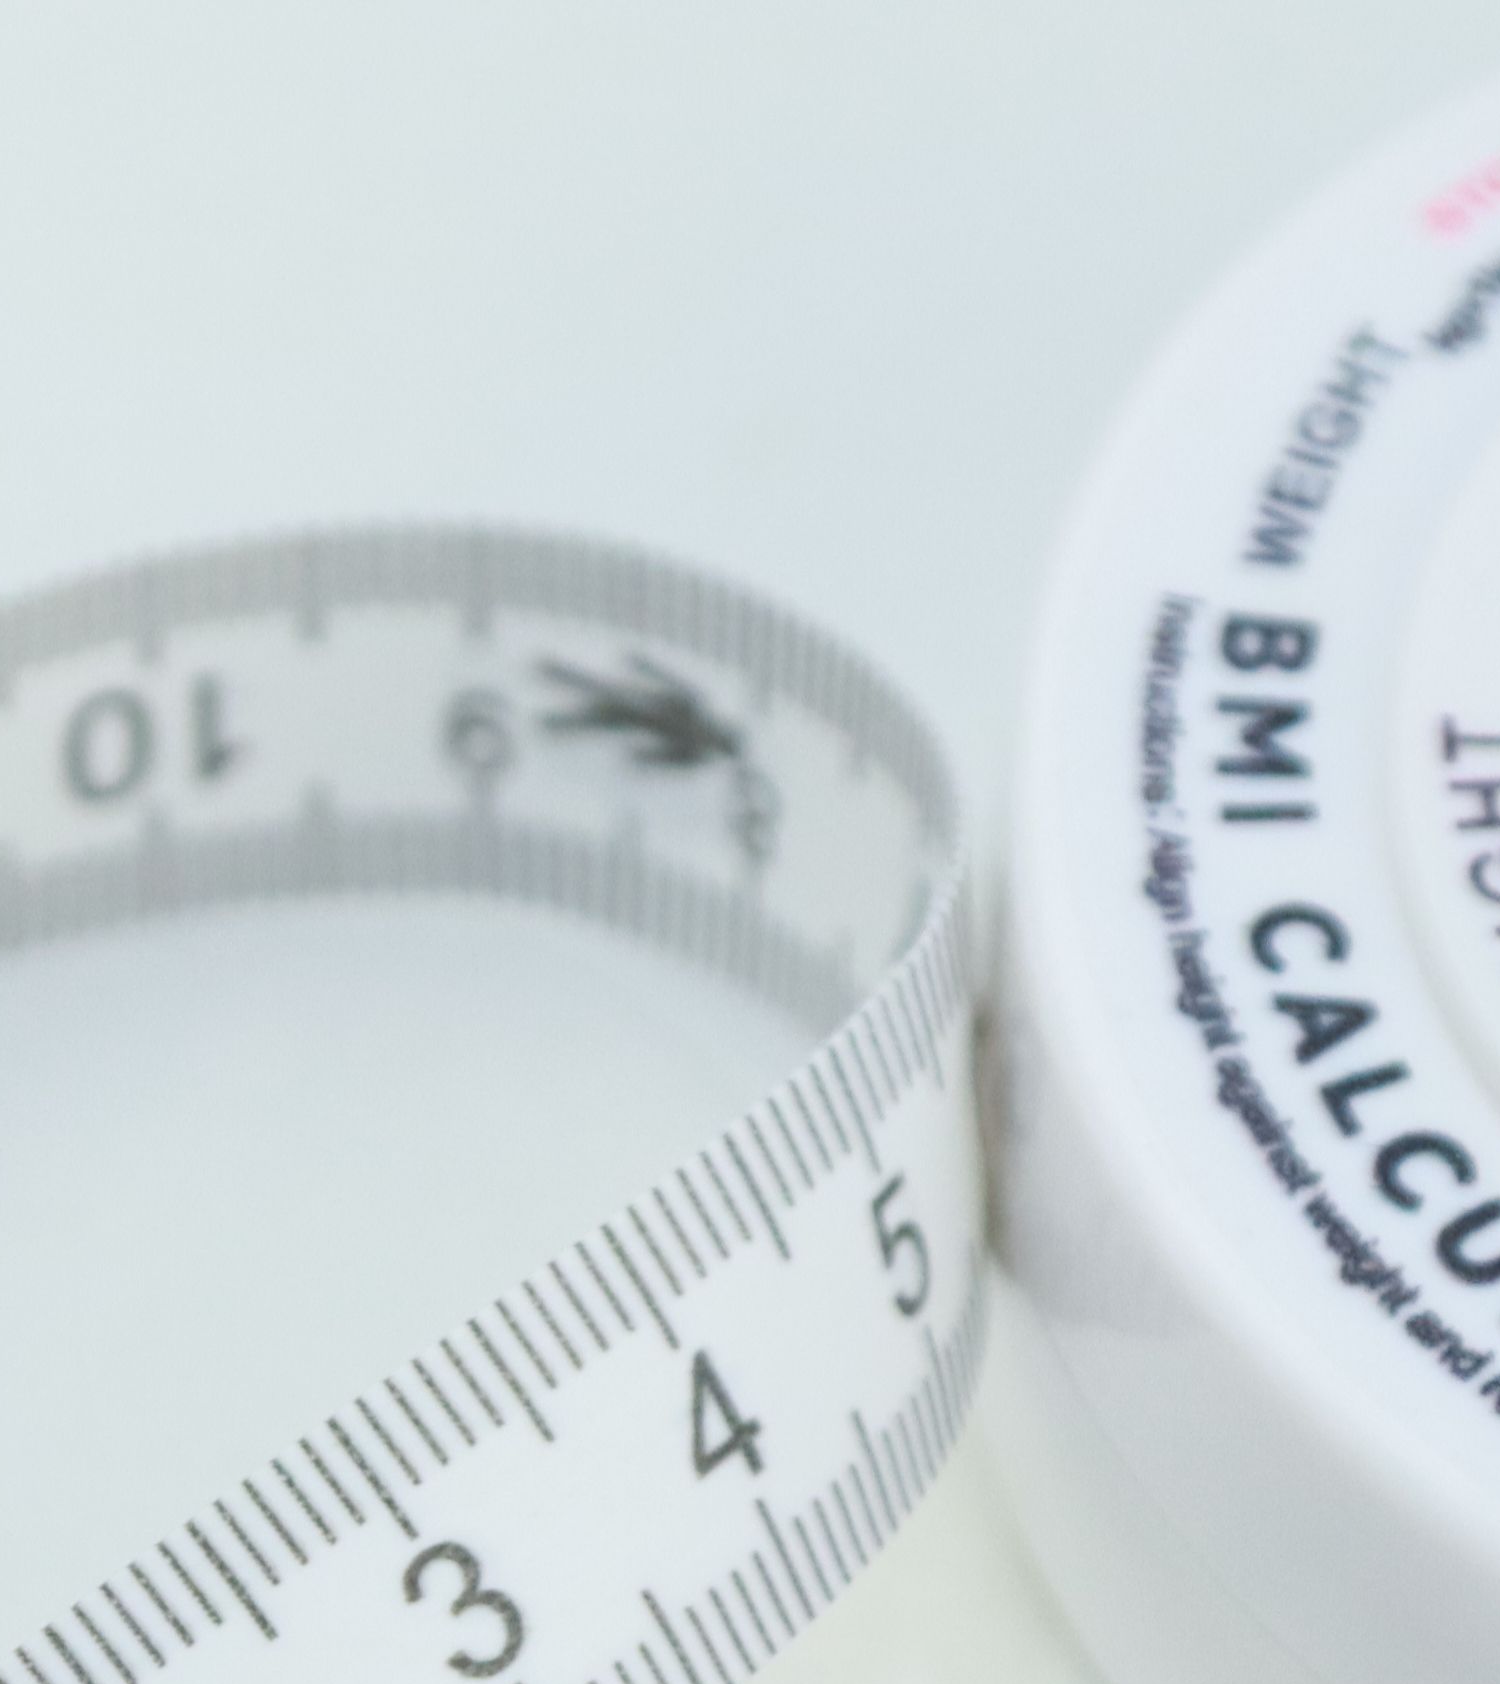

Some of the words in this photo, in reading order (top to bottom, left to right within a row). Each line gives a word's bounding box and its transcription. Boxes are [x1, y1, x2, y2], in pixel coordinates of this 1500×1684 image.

[1245, 324, 1408, 567] WEIGHT
[59, 674, 248, 804] 10
[1215, 613, 1319, 821] BMI
[402, 1541, 525, 1679] 3
[690, 1348, 763, 1480] 4
[870, 1174, 931, 1317] 5
[1405, 1311, 1493, 1381] and
